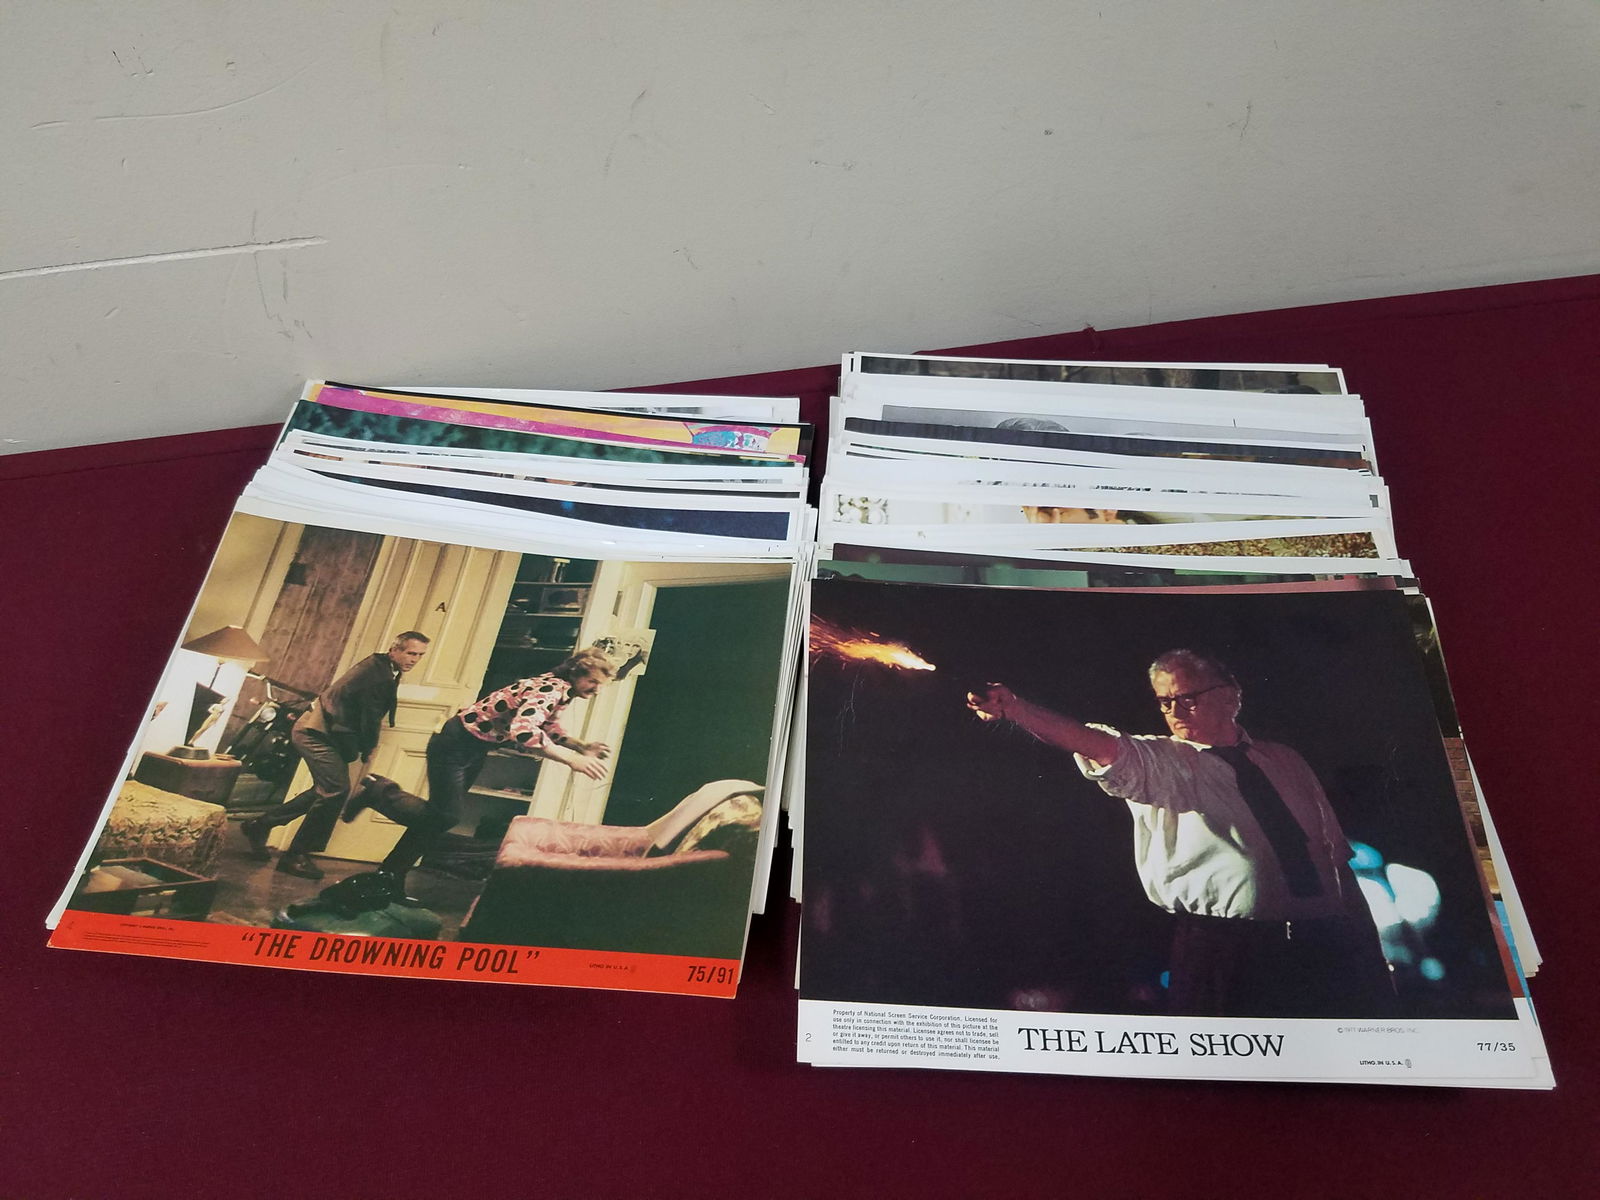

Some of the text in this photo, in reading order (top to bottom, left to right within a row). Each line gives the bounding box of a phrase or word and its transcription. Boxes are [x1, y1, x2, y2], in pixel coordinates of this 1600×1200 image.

[434, 601, 447, 613] A
[309, 936, 447, 970] DROWNING
[687, 965, 735, 985] 75/91
[805, 1032, 812, 1042] 2
[1018, 1027, 1285, 1057] THE LATE SHOW
[1476, 1042, 1516, 1052] 77/35
